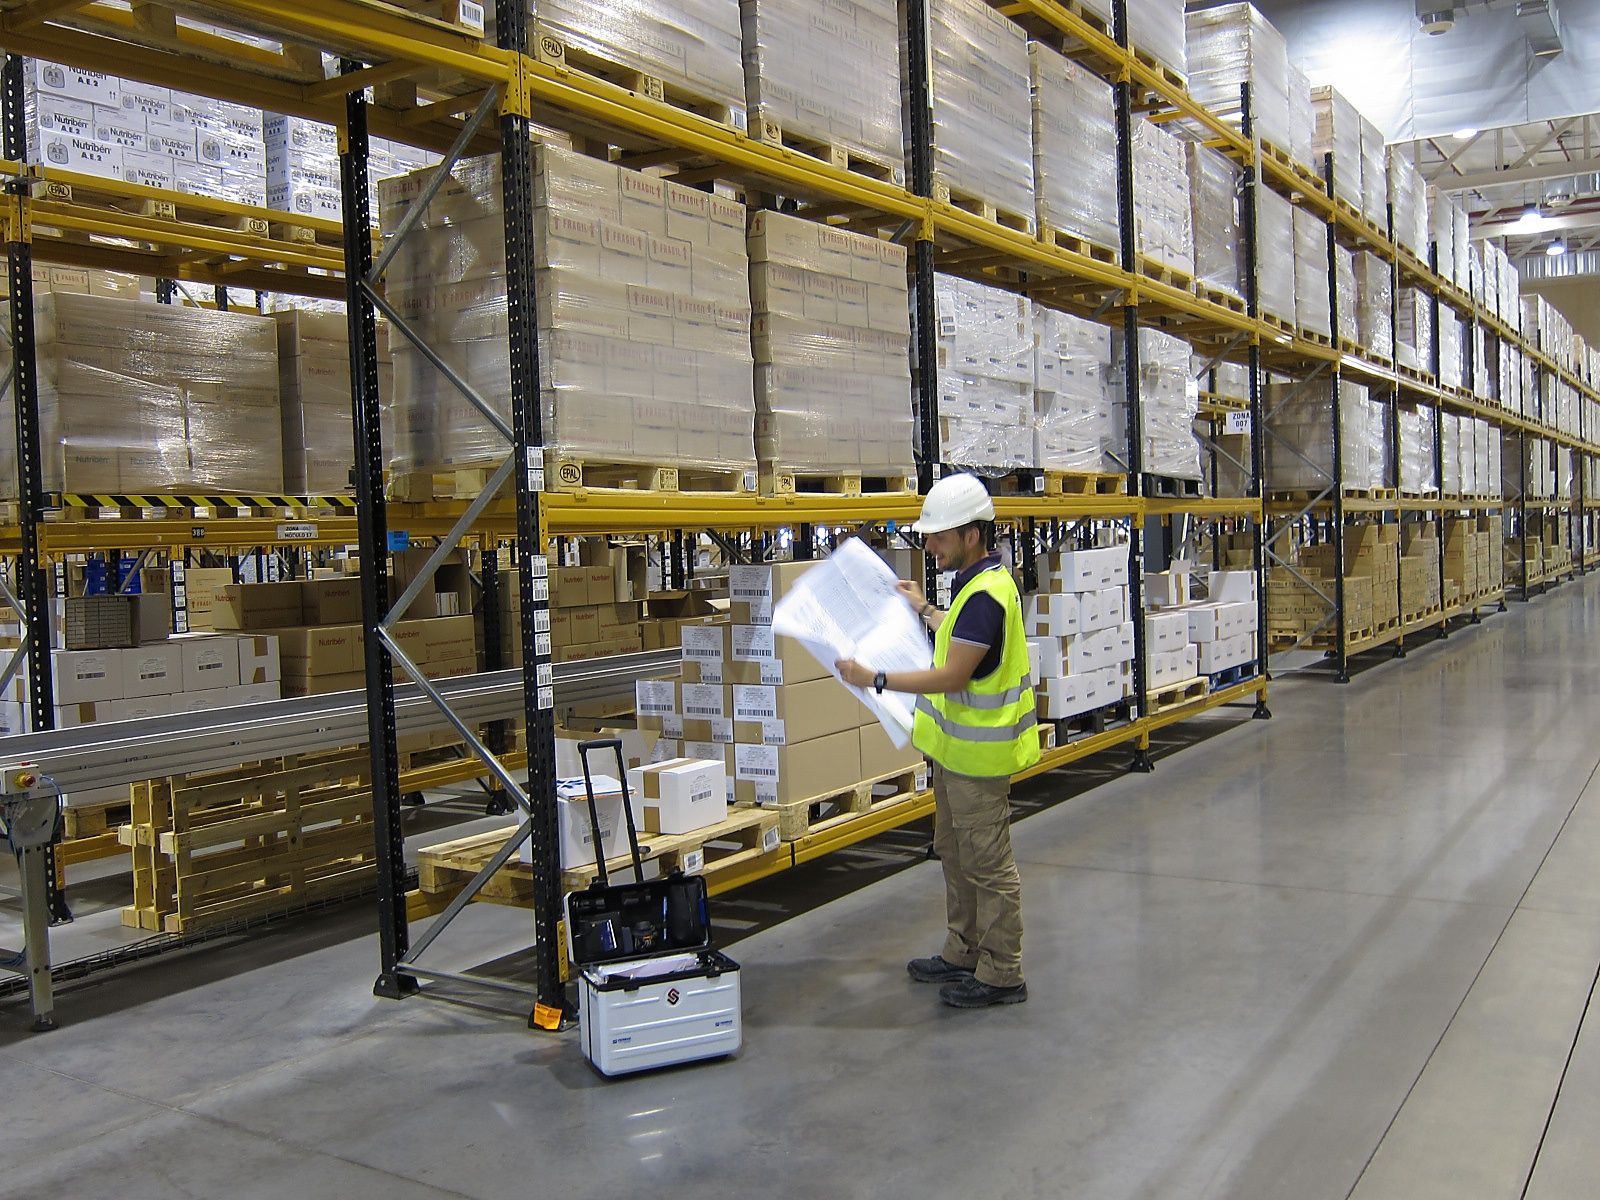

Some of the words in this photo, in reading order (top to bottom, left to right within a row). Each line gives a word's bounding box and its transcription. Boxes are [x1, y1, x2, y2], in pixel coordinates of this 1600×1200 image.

[543, 38, 560, 55] EPAL
[54, 114, 89, 129] Nutribén
[110, 127, 143, 141] Nutribén
[72, 138, 112, 154] Nutribén
[50, 185, 66, 196] EPAL
[633, 181, 656, 196] FRAGIL
[677, 193, 700, 206] FRAGIL
[252, 221, 265, 230] EUR
[563, 218, 589, 232] FRAGIL
[613, 232, 636, 246] FRAGIL
[659, 244, 681, 257] FRAGIL
[641, 294, 665, 307] FRAGIL
[1232, 412, 1250, 420] ZONA
[1235, 420, 1248, 428] 007
[562, 468, 579, 479] EPAL
[318, 637, 347, 646] Nutribén
[394, 630, 420, 640] Nutribén
[449, 665, 473, 675] Nutribén
